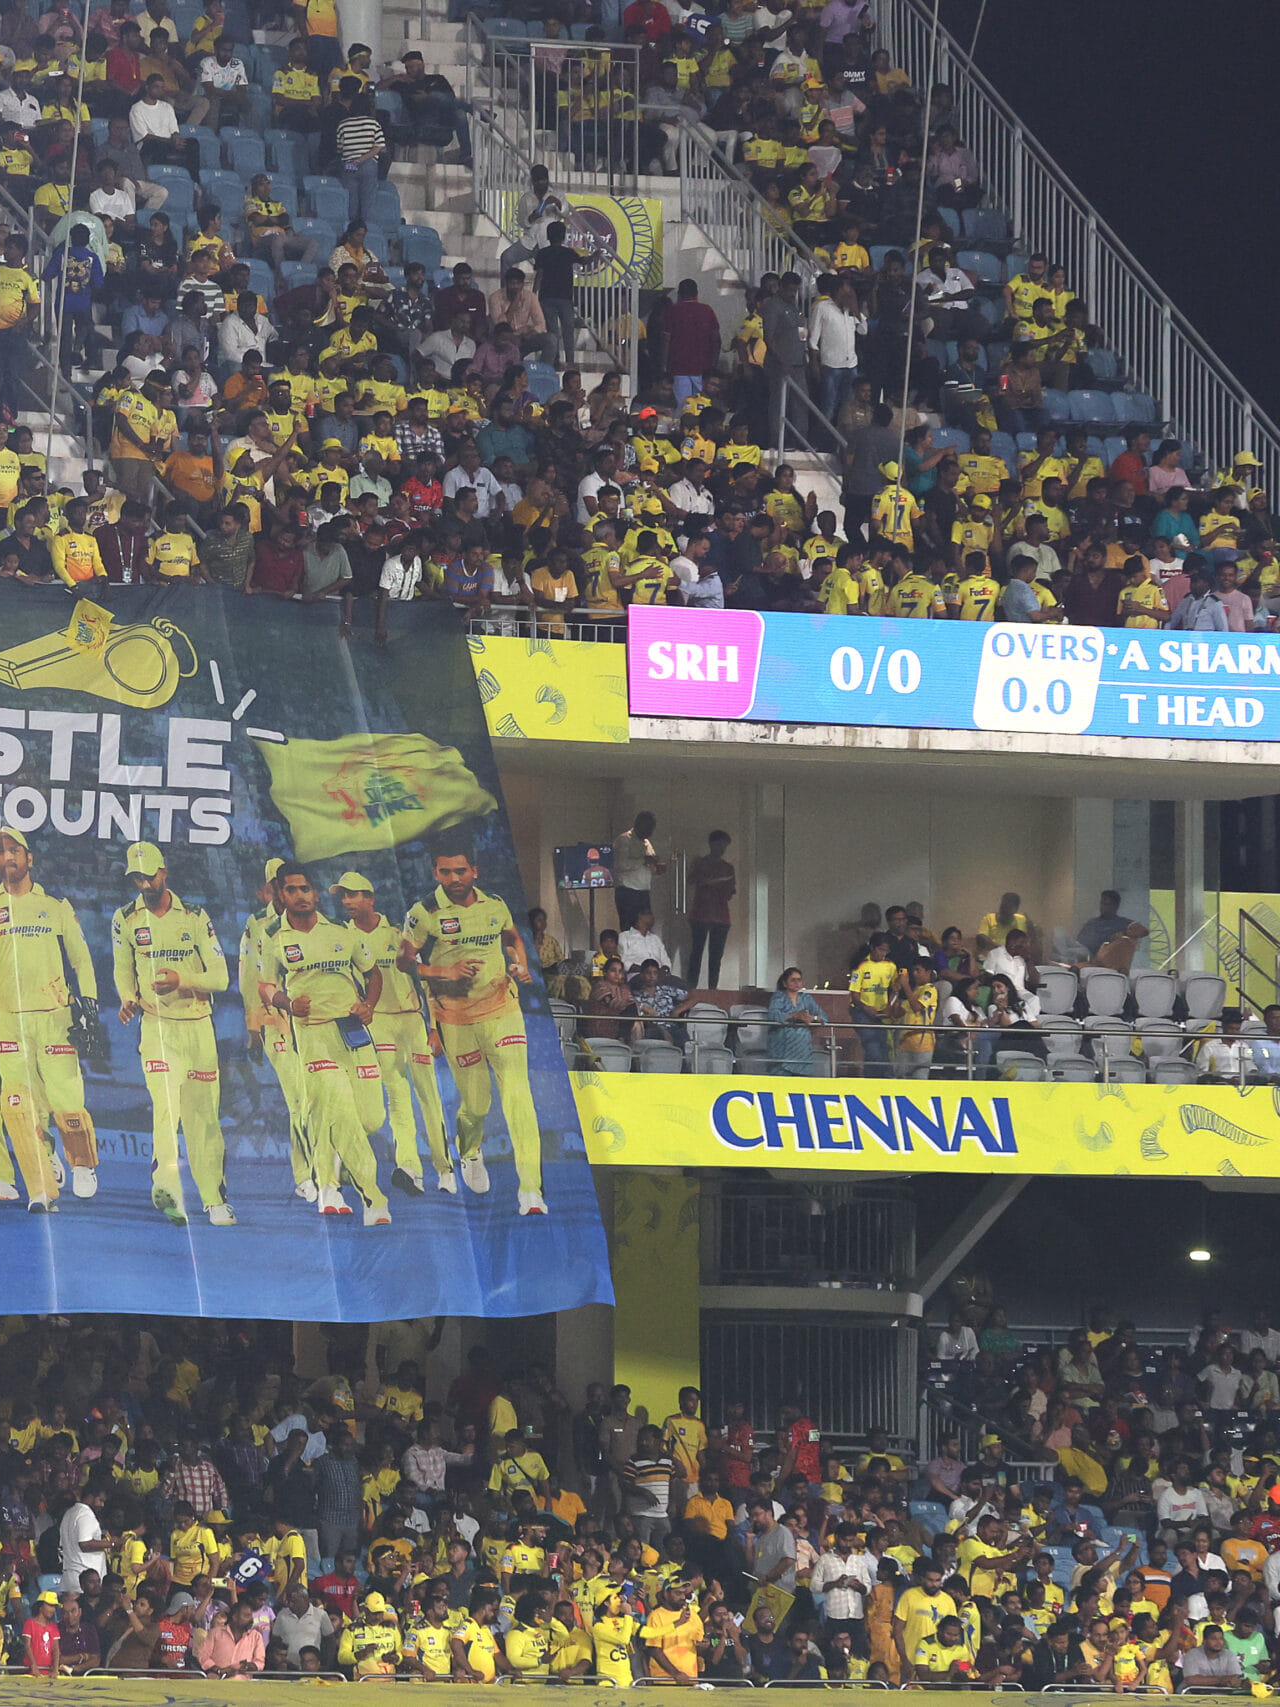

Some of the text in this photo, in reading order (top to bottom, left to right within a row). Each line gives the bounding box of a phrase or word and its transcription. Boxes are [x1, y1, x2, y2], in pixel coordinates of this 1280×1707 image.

[843, 70, 866, 79] OMMY
[898, 588, 924, 599] FedEx
[969, 587, 994, 597] FedEx
[973, 600, 991, 621] 7
[647, 640, 740, 684] SRH
[991, 632, 1099, 663] OVERS
[829, 645, 923, 695] 0/0
[1002, 677, 1072, 715] 0.0
[1119, 693, 1265, 728] T HEAD
[711, 1090, 1018, 1155] CHENNAI
[609, 1647, 628, 1662] CS
